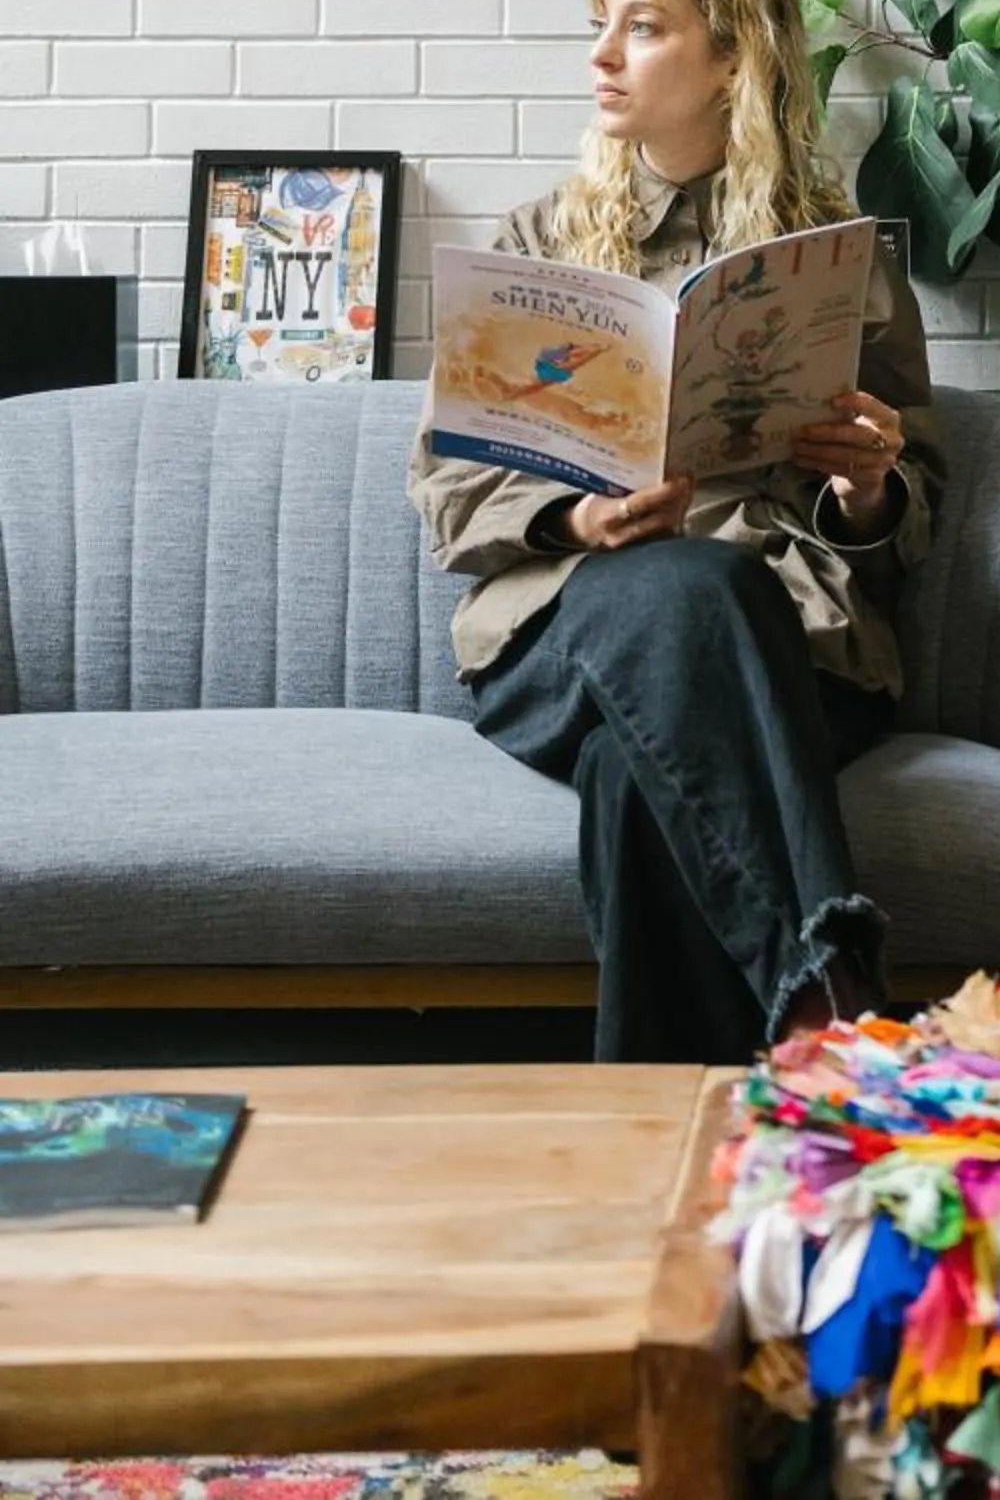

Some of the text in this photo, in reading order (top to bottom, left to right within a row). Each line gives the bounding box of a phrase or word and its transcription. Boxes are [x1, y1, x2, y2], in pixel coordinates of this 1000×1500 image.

[256, 250, 332, 321] NY
[491, 290, 566, 316] SHEN
[575, 307, 630, 337] YUN
